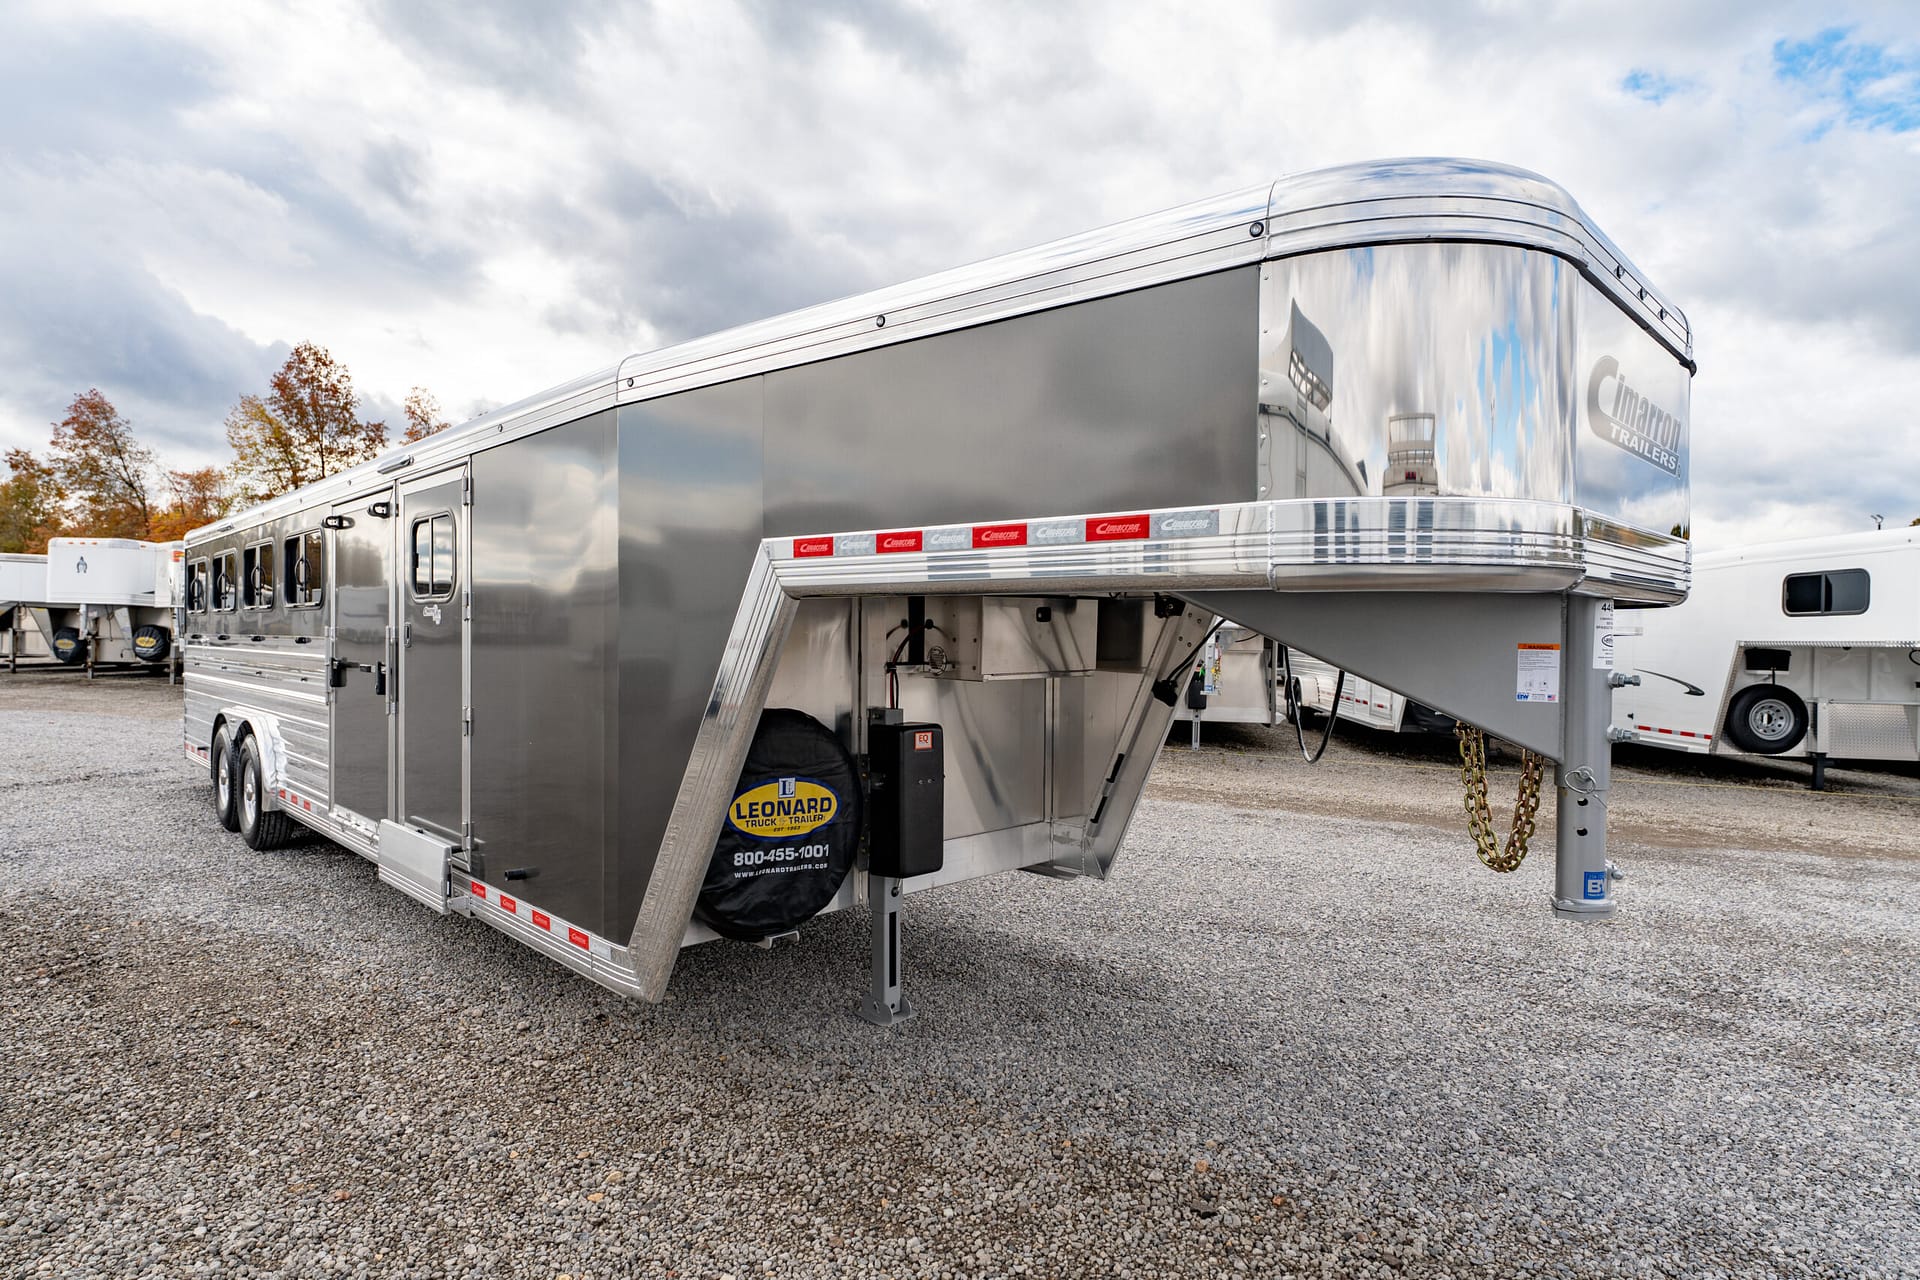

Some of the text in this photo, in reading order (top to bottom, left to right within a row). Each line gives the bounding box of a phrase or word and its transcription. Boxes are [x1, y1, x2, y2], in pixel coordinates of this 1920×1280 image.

[1587, 355, 1681, 454] Cimarron
[1610, 422, 1677, 470] TRAILERS
[1095, 522, 1141, 535] Cimarron
[919, 734, 929, 743] EQ
[735, 797, 832, 820] LEONARD
[745, 818, 777, 828] TRUCK
[734, 843, 830, 867] 800-455-1001
